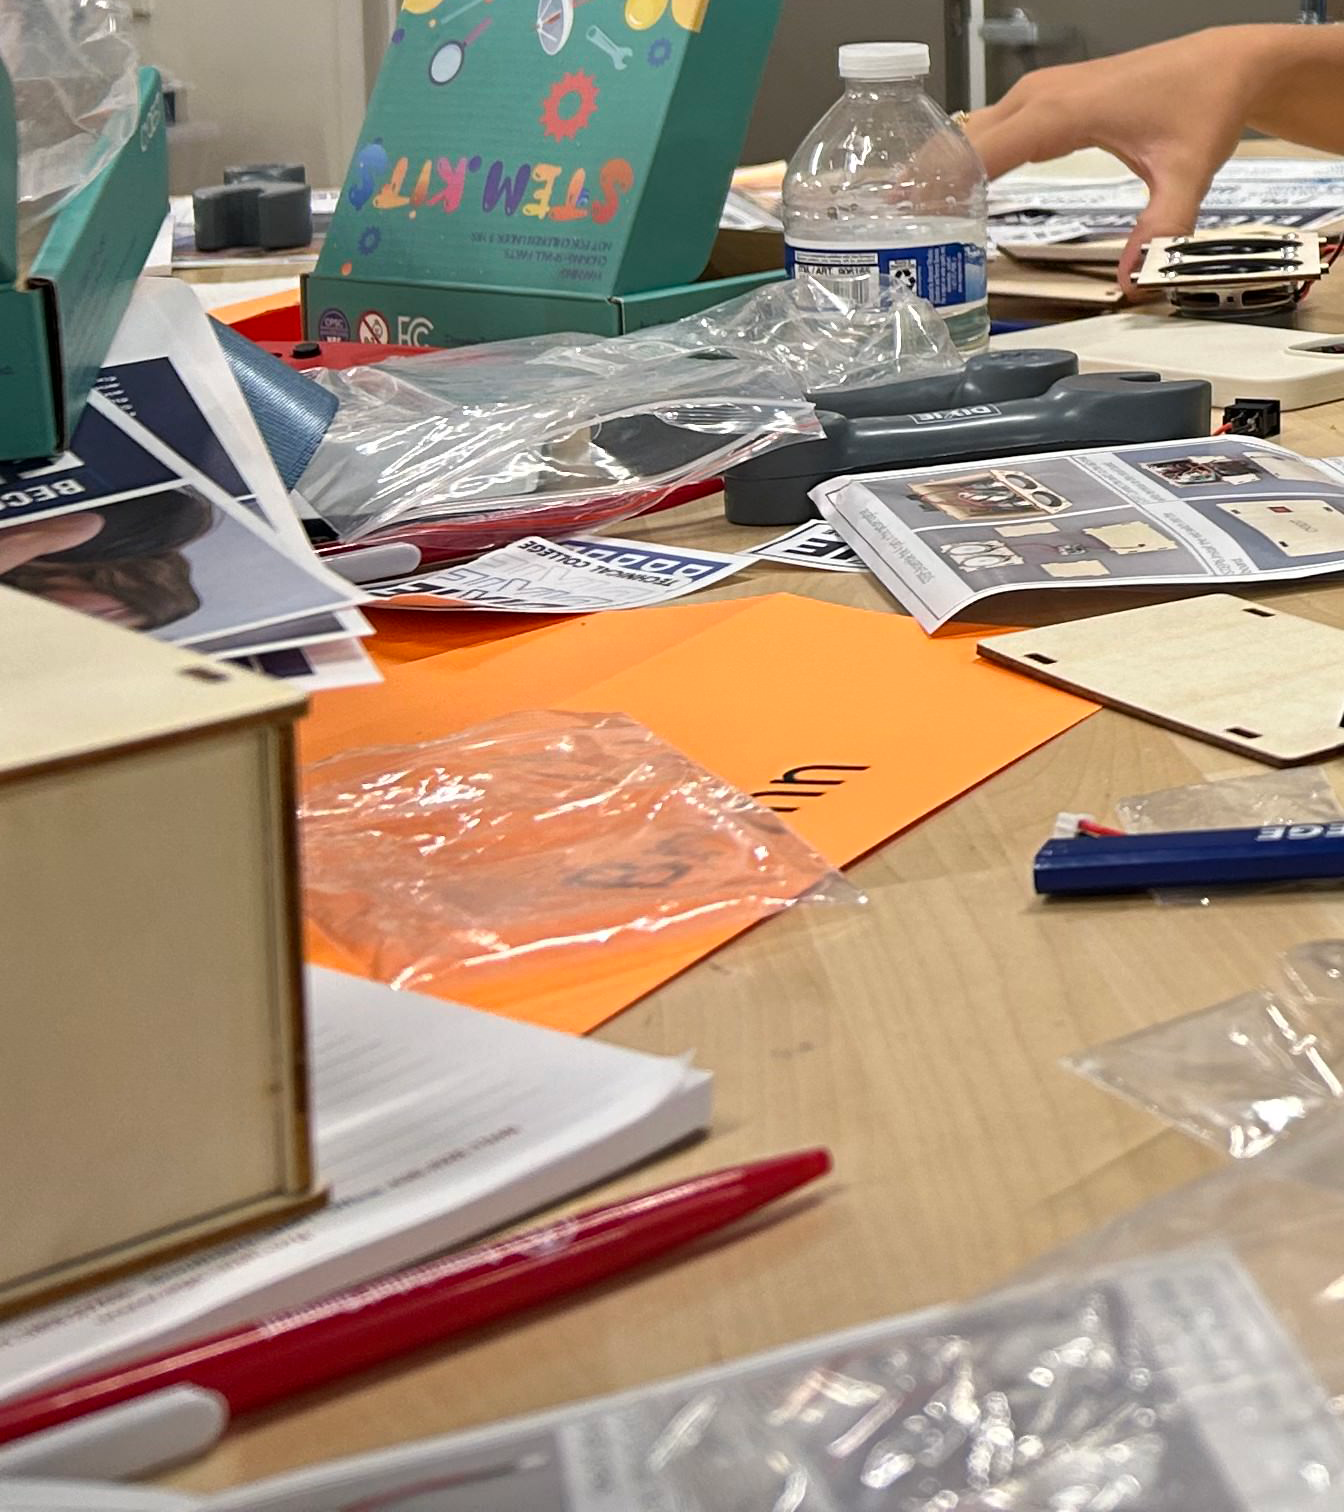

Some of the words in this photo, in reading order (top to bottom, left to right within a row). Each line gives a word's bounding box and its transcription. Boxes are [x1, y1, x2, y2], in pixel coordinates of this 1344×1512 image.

[915, 405, 992, 422] DIXIE
[0, 477, 87, 512] BEC
[516, 540, 592, 571] COLLEGE
[589, 564, 681, 588] TECHNICAL
